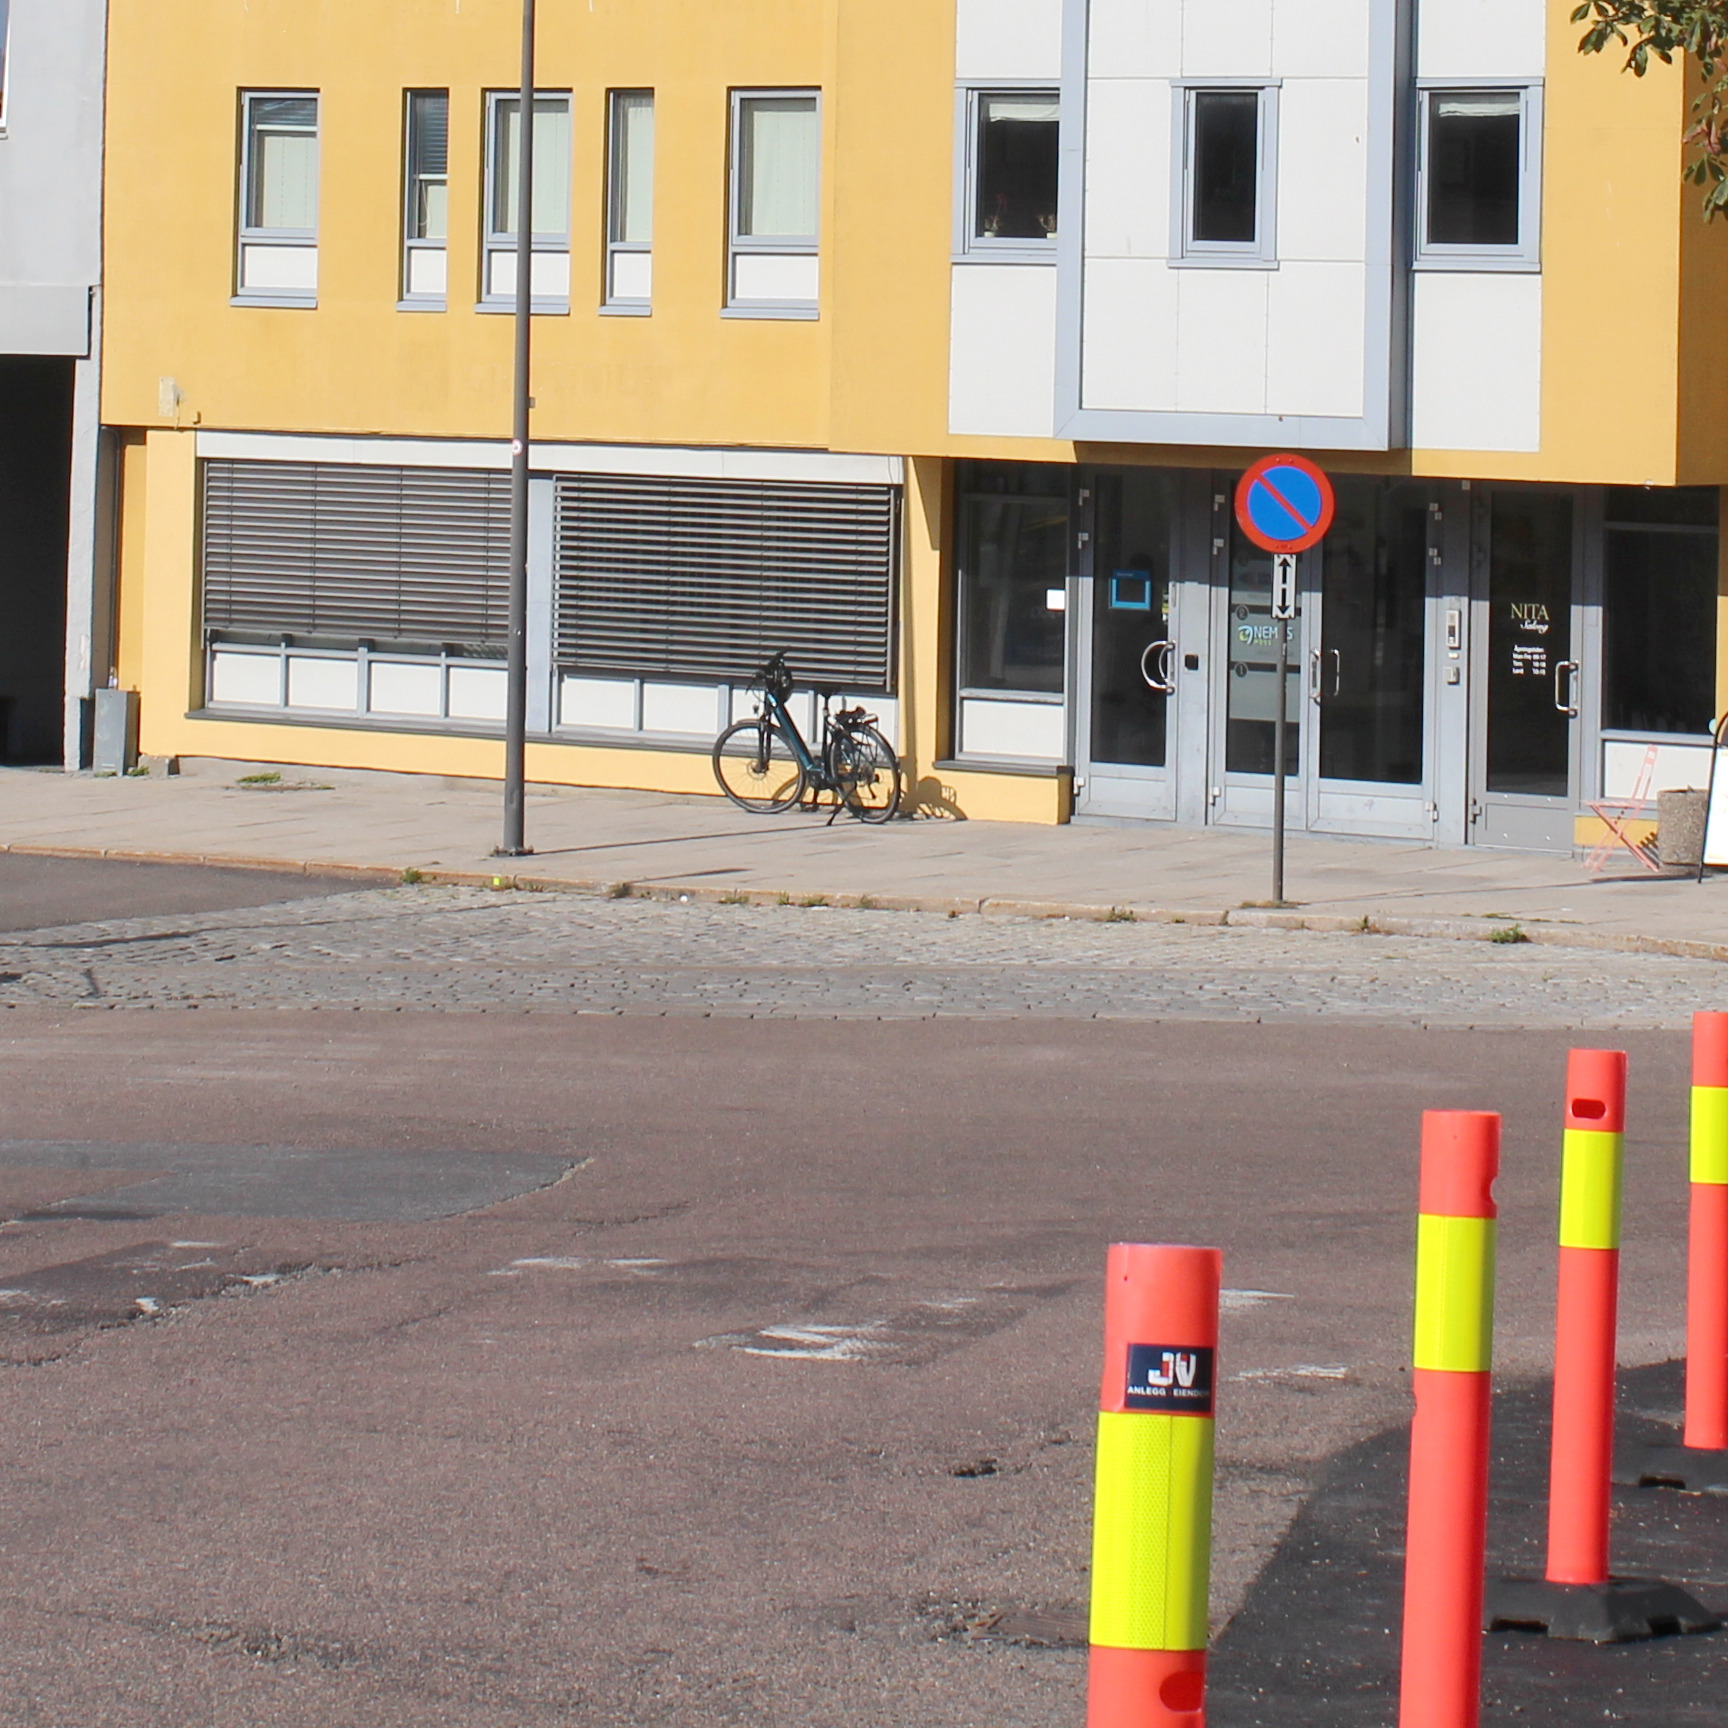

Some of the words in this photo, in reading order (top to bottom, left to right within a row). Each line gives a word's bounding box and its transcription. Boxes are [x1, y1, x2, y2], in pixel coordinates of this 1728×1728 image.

[1510, 602, 1550, 621] NITA
[1253, 625, 1293, 640] NEMS
[1147, 1351, 1198, 1388] JV
[1127, 1386, 1167, 1397] ANLEGG
